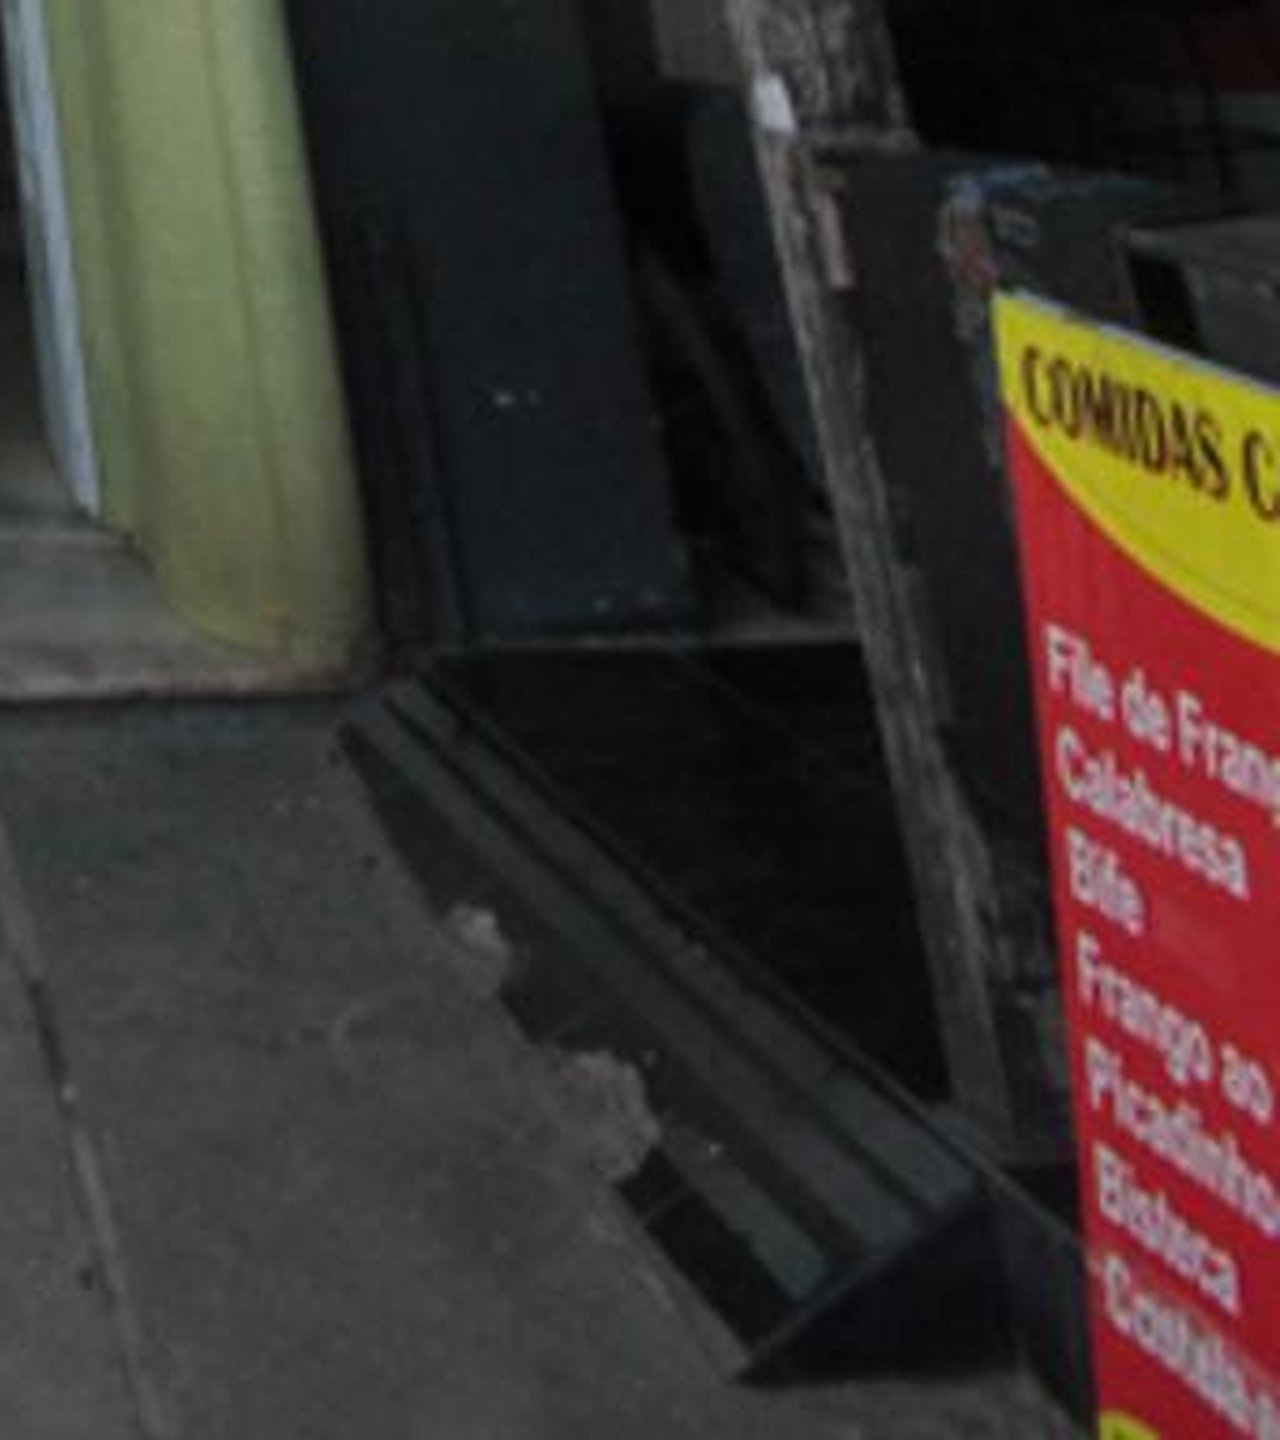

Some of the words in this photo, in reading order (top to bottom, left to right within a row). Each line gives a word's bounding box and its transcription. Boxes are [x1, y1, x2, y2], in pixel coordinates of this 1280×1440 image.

[1021, 343, 1231, 503] COMIDAS
[1121, 668, 1172, 753] de
[1055, 723, 1250, 902] Calabresa
[1076, 930, 1214, 1083] Frango
